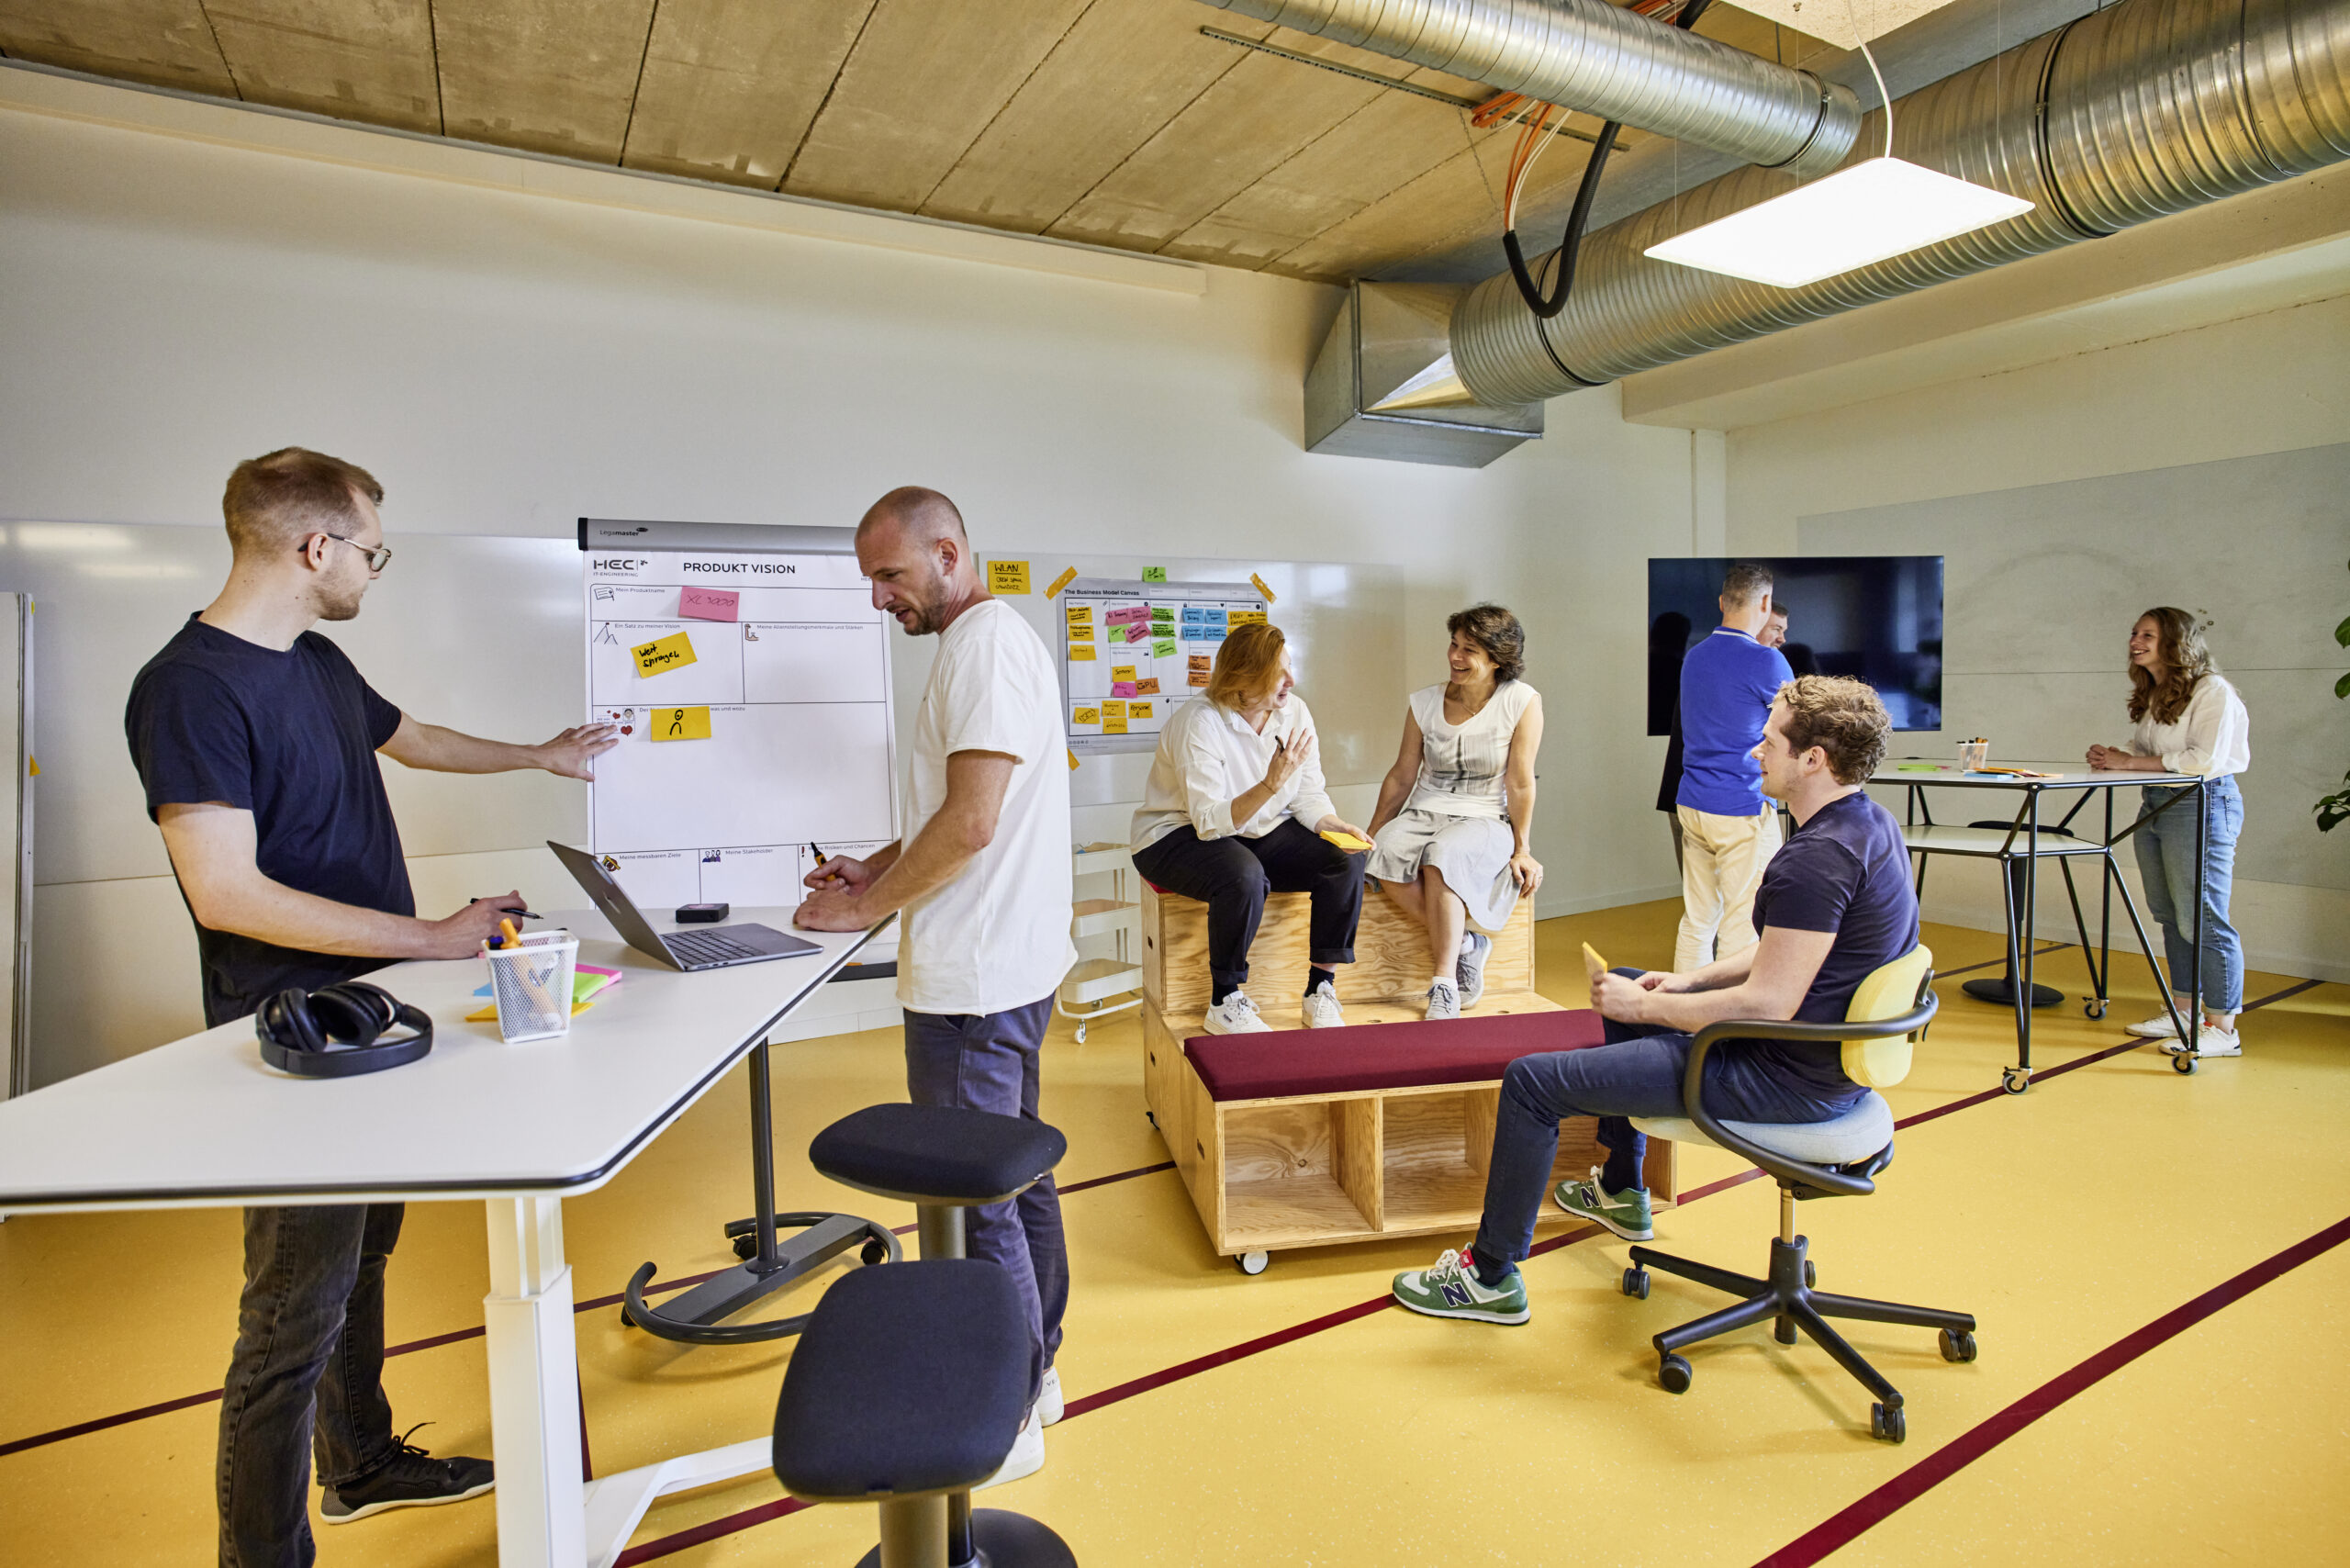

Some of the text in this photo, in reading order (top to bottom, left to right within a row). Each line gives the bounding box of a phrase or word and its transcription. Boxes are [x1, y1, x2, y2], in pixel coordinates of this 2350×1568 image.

[593, 559, 634, 570] HEC
[683, 562, 796, 574] PRODUKT VISION
[994, 564, 1019, 572] WLAN
[1136, 680, 1157, 690] GPU
[1580, 1185, 1601, 1208] N
[1439, 1282, 1473, 1307] N
